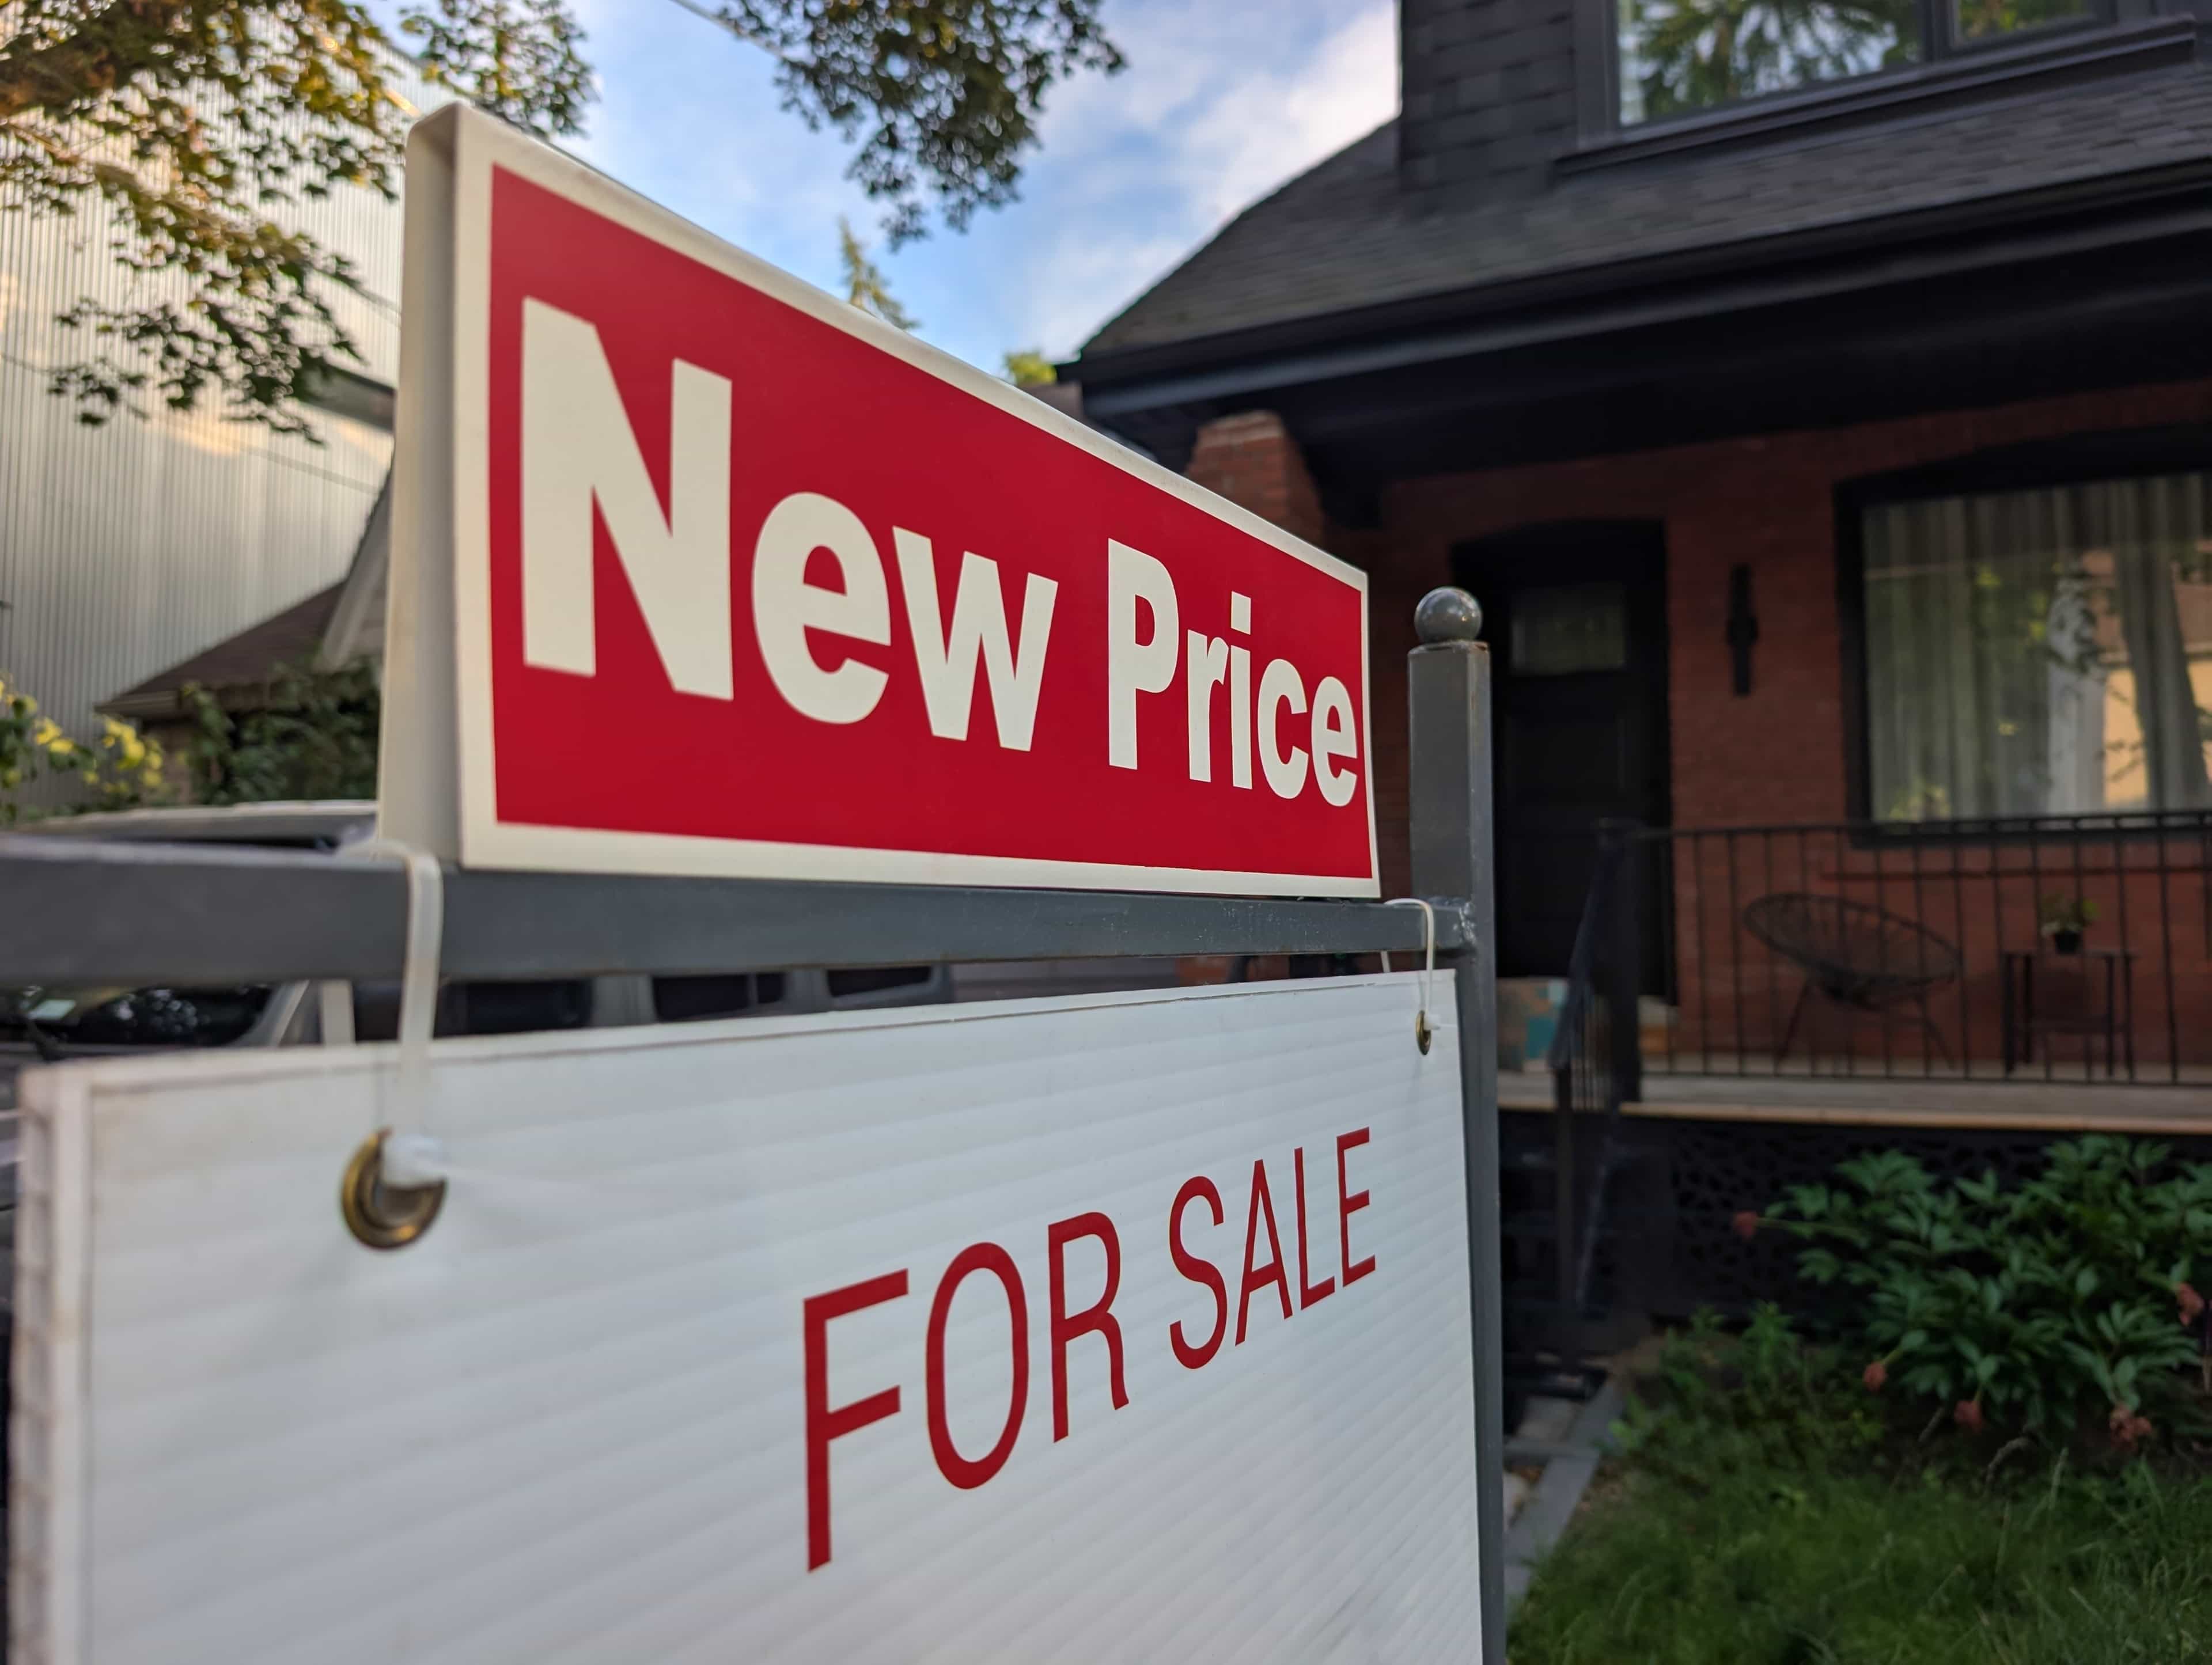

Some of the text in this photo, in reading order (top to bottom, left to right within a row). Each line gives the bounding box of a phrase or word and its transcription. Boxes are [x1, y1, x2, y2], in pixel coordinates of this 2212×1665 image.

[521, 297, 1357, 807] New Price
[804, 1127, 1376, 1572] FOR SALE
